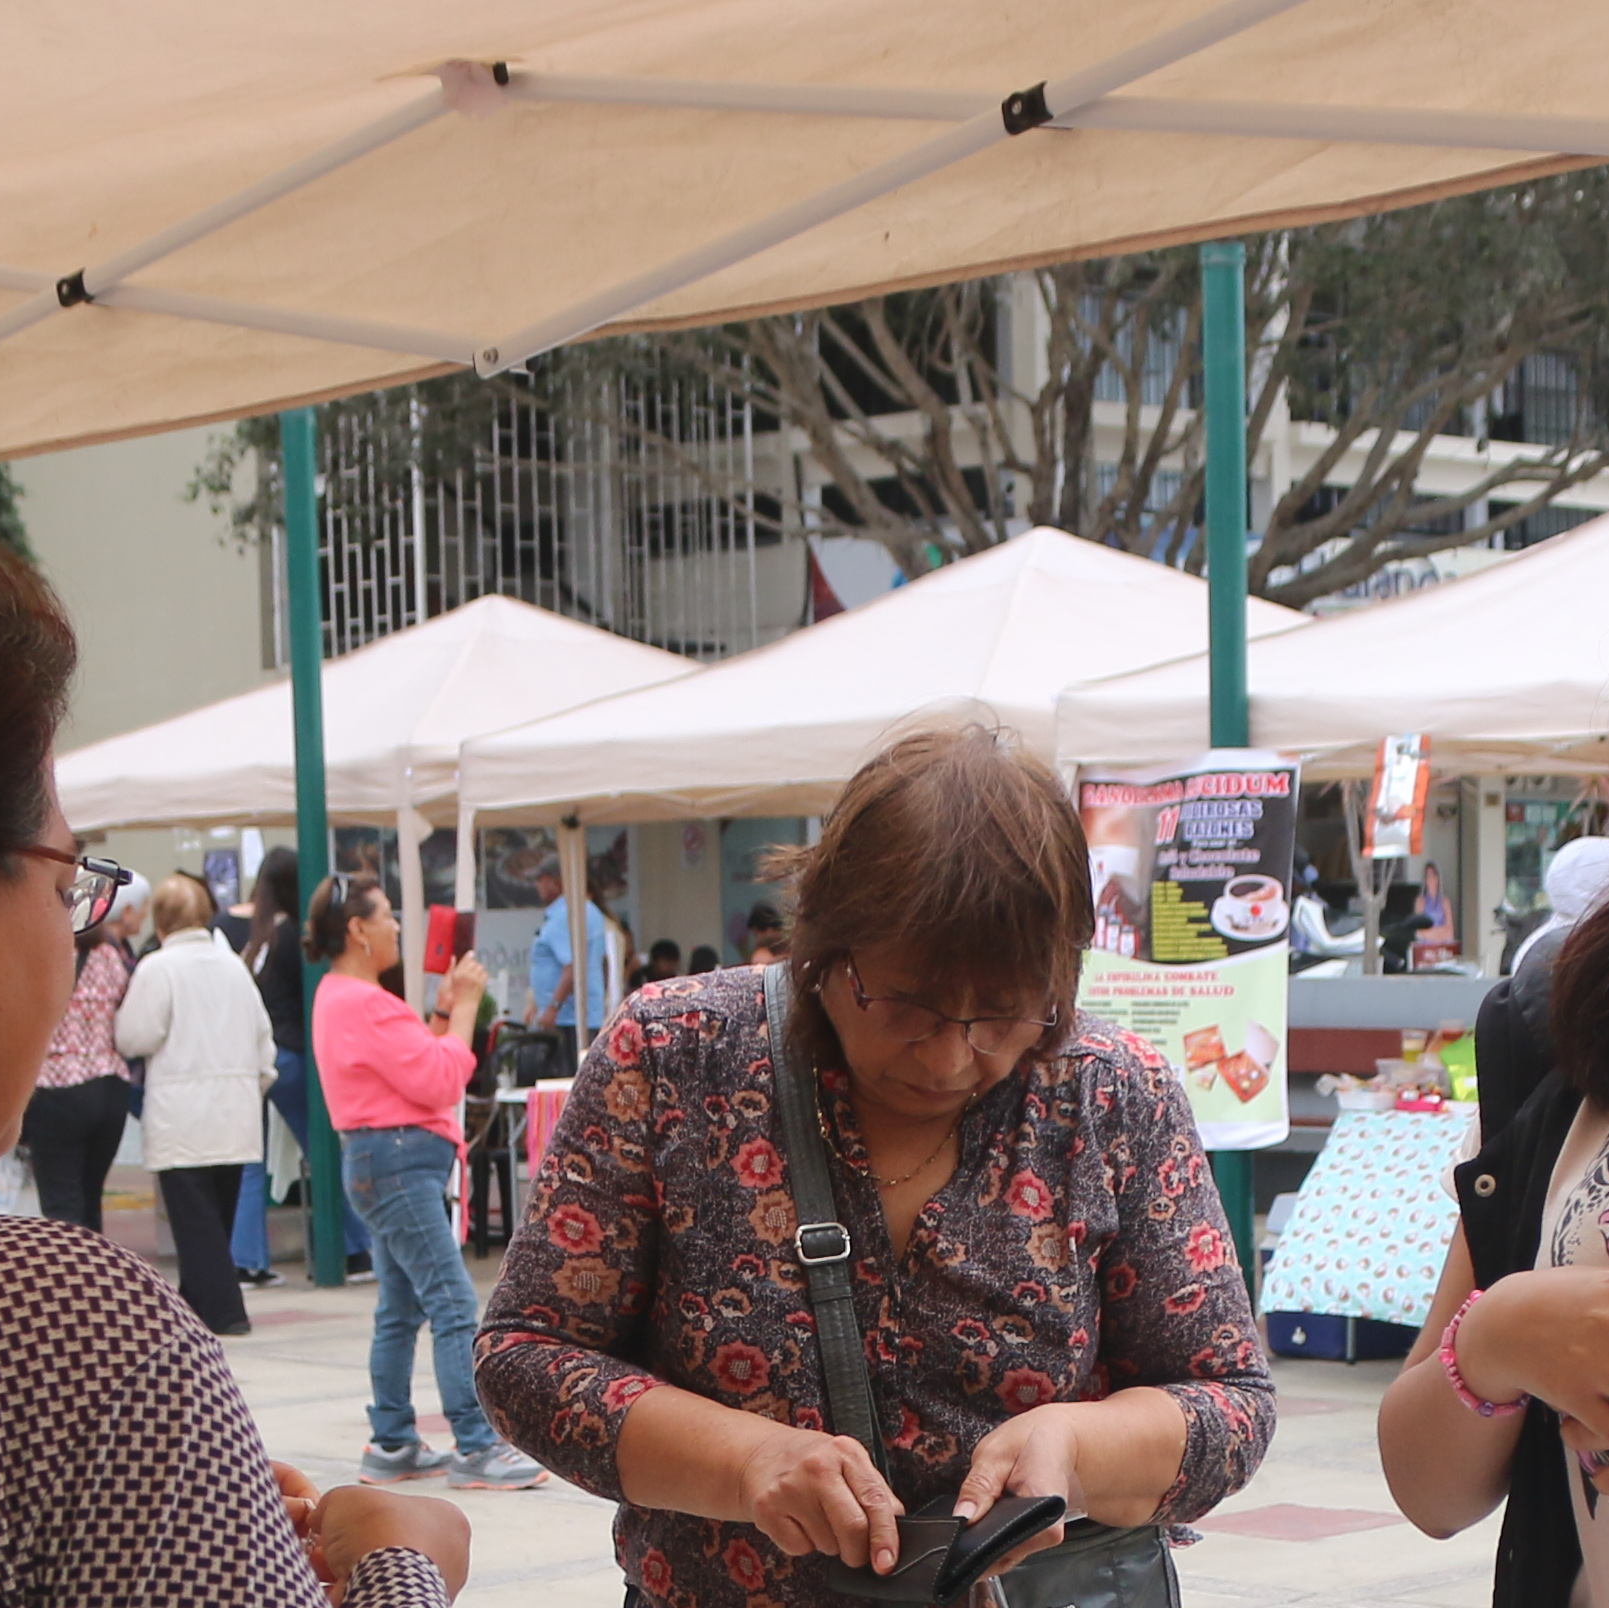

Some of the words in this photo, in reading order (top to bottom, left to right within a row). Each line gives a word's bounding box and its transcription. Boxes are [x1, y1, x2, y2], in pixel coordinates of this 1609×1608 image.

[1156, 806, 1180, 844] 11
[1184, 820, 1255, 840] RAZONES
[1172, 986, 1185, 996] DE
[1190, 985, 1235, 996] SALUD
